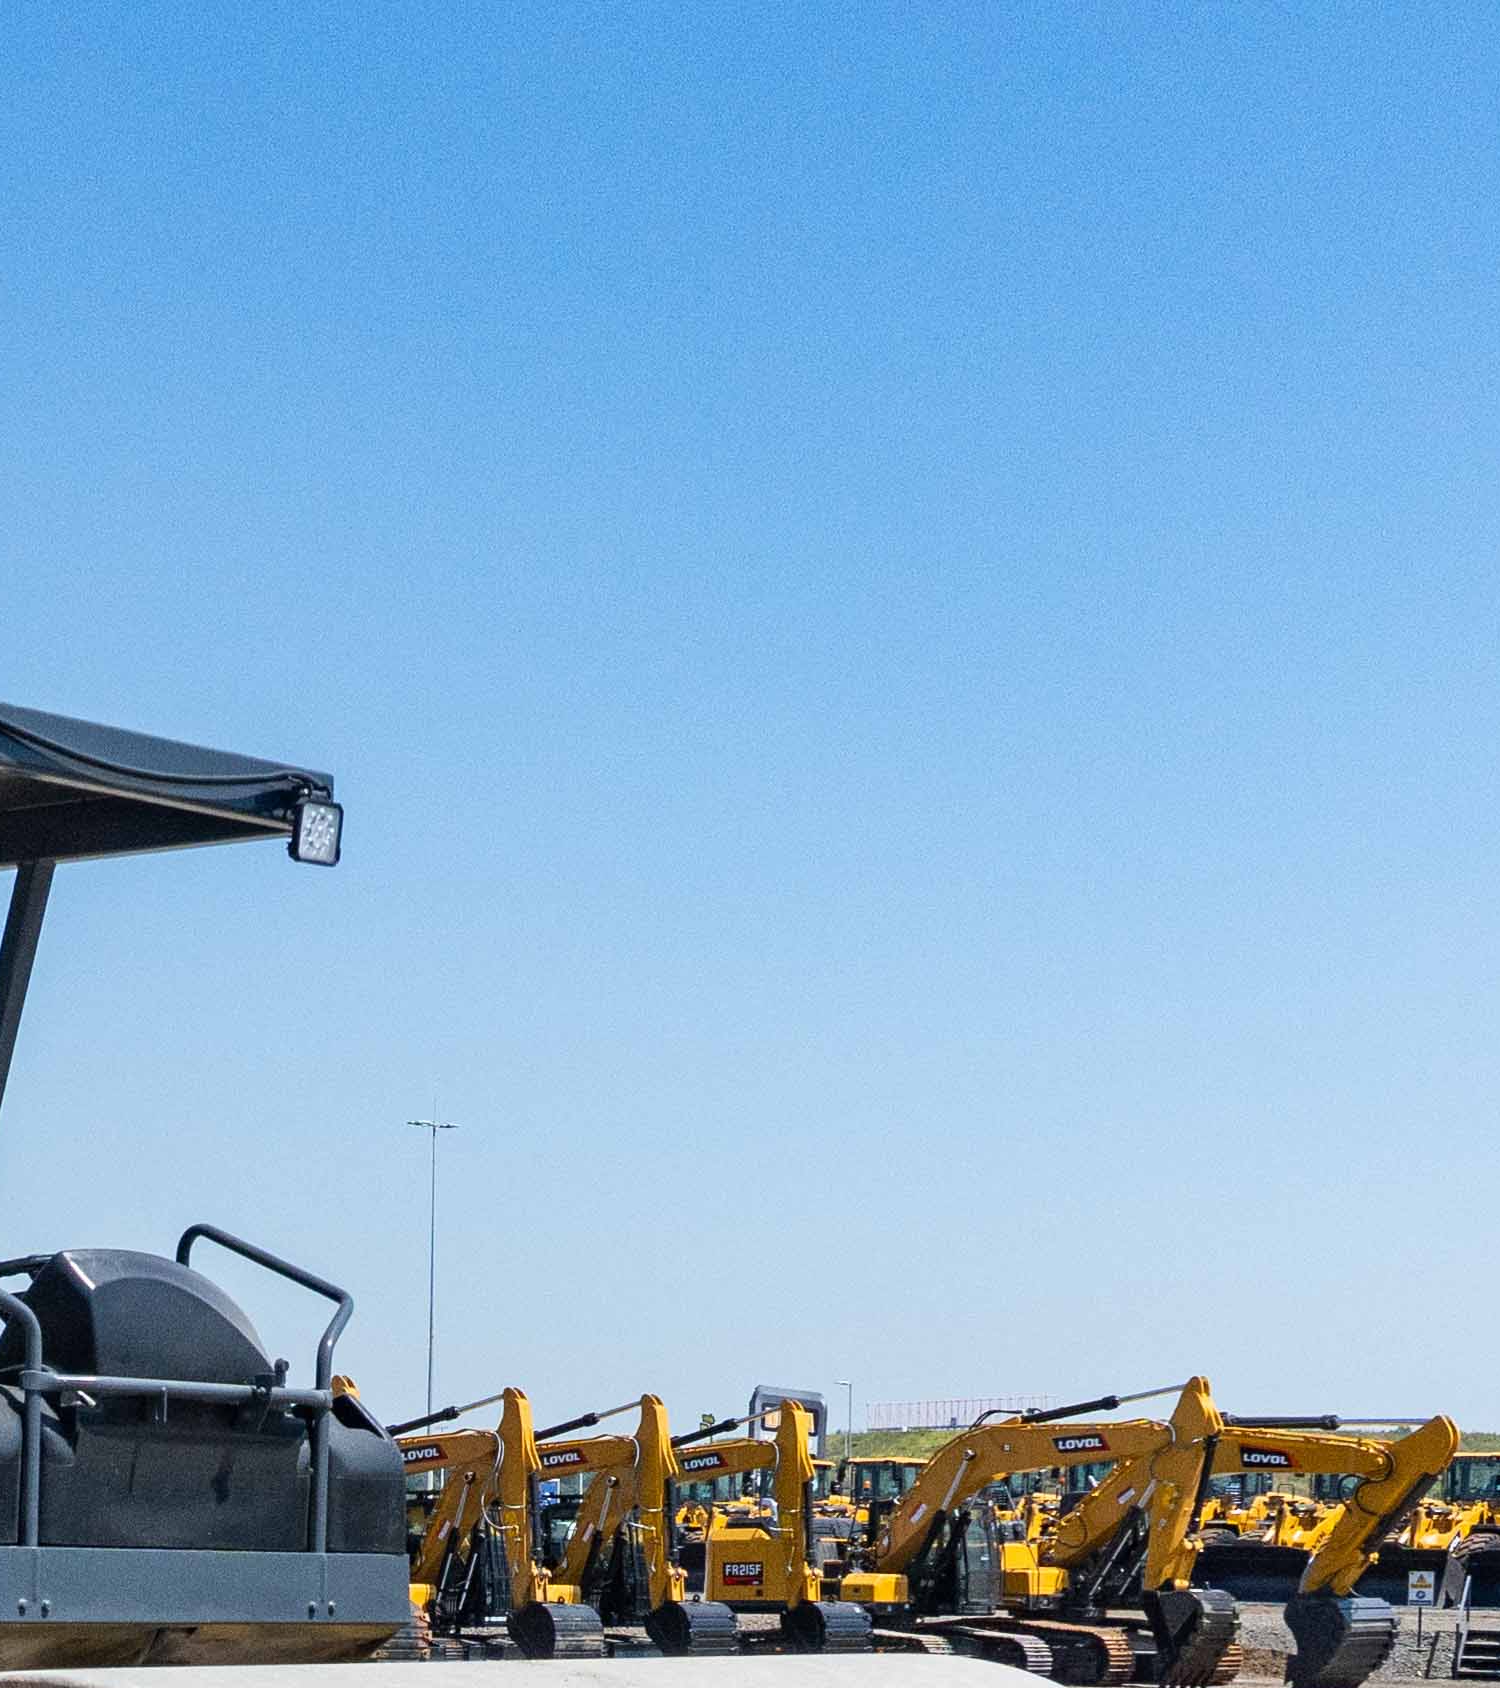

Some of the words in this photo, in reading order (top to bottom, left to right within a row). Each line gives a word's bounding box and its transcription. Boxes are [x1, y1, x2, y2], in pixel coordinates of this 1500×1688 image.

[1058, 1437, 1102, 1450] LOVOL
[401, 1447, 440, 1462] LOVOL
[543, 1452, 581, 1466] LOVOL
[1243, 1452, 1289, 1465] LOVOL
[684, 1455, 721, 1470] LOVOL
[725, 1564, 761, 1576] FR215F
